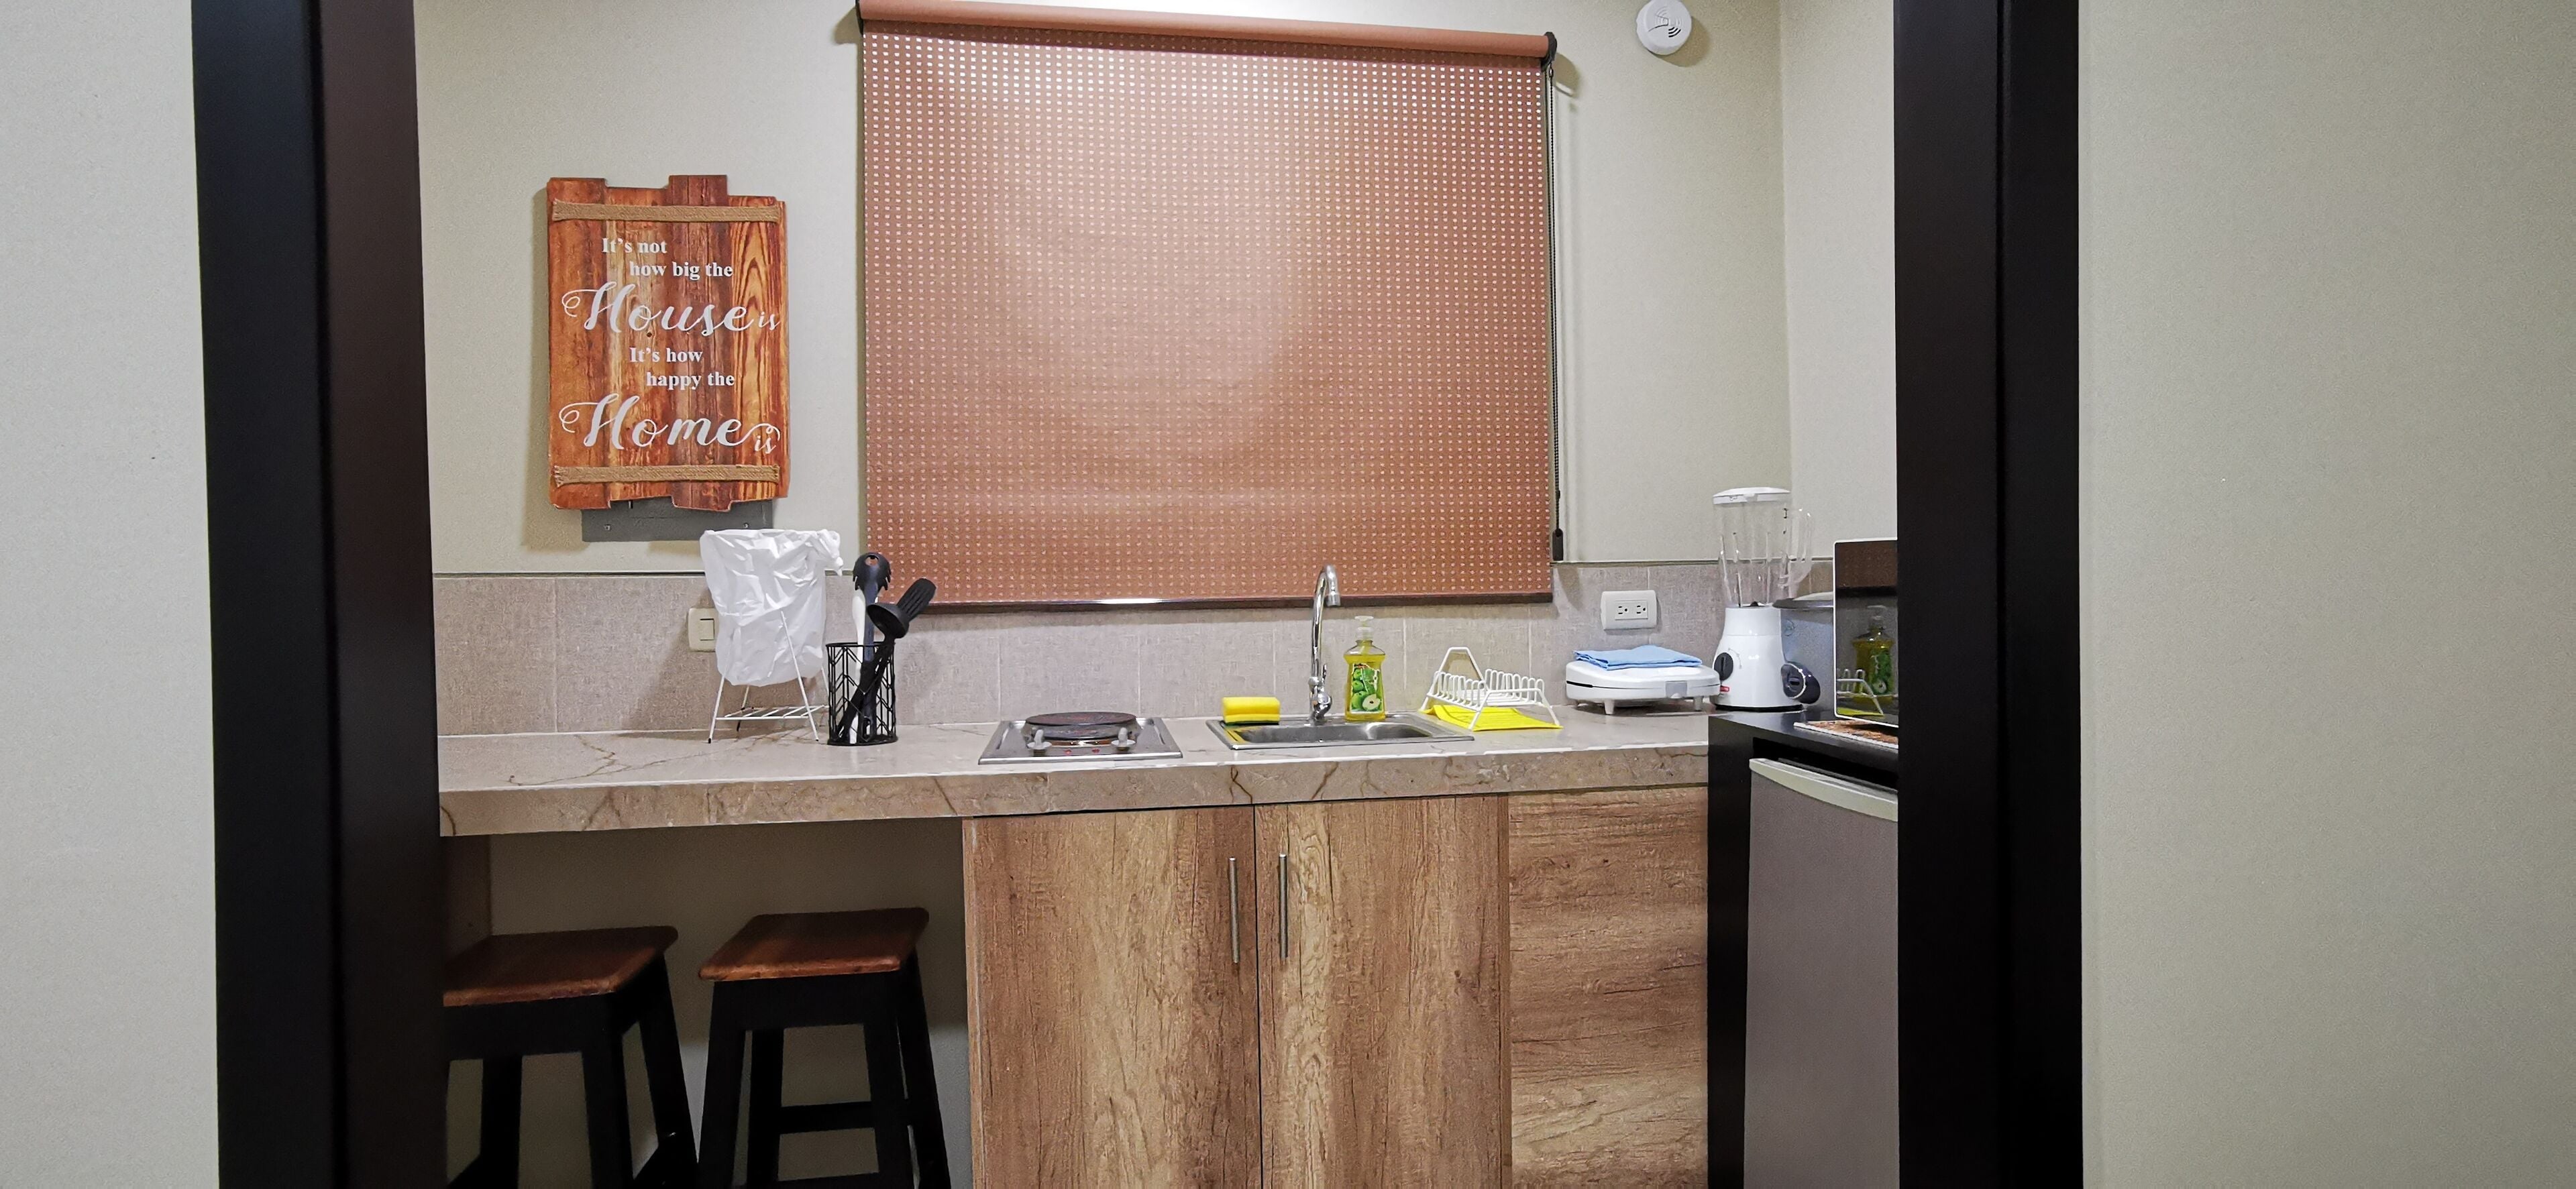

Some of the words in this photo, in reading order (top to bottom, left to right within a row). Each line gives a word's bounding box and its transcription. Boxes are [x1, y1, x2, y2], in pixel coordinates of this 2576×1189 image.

[602, 237, 632, 253] It's
[639, 242, 667, 253] not
[630, 262, 666, 276] how
[672, 262, 700, 280] big
[706, 262, 733, 276] the
[561, 282, 753, 336] House
[757, 311, 781, 331] is
[630, 347, 660, 363] It's
[666, 347, 703, 362] how
[647, 372, 702, 390] happy
[708, 372, 735, 386] the
[559, 393, 781, 450] Home
[755, 435, 777, 454] is
